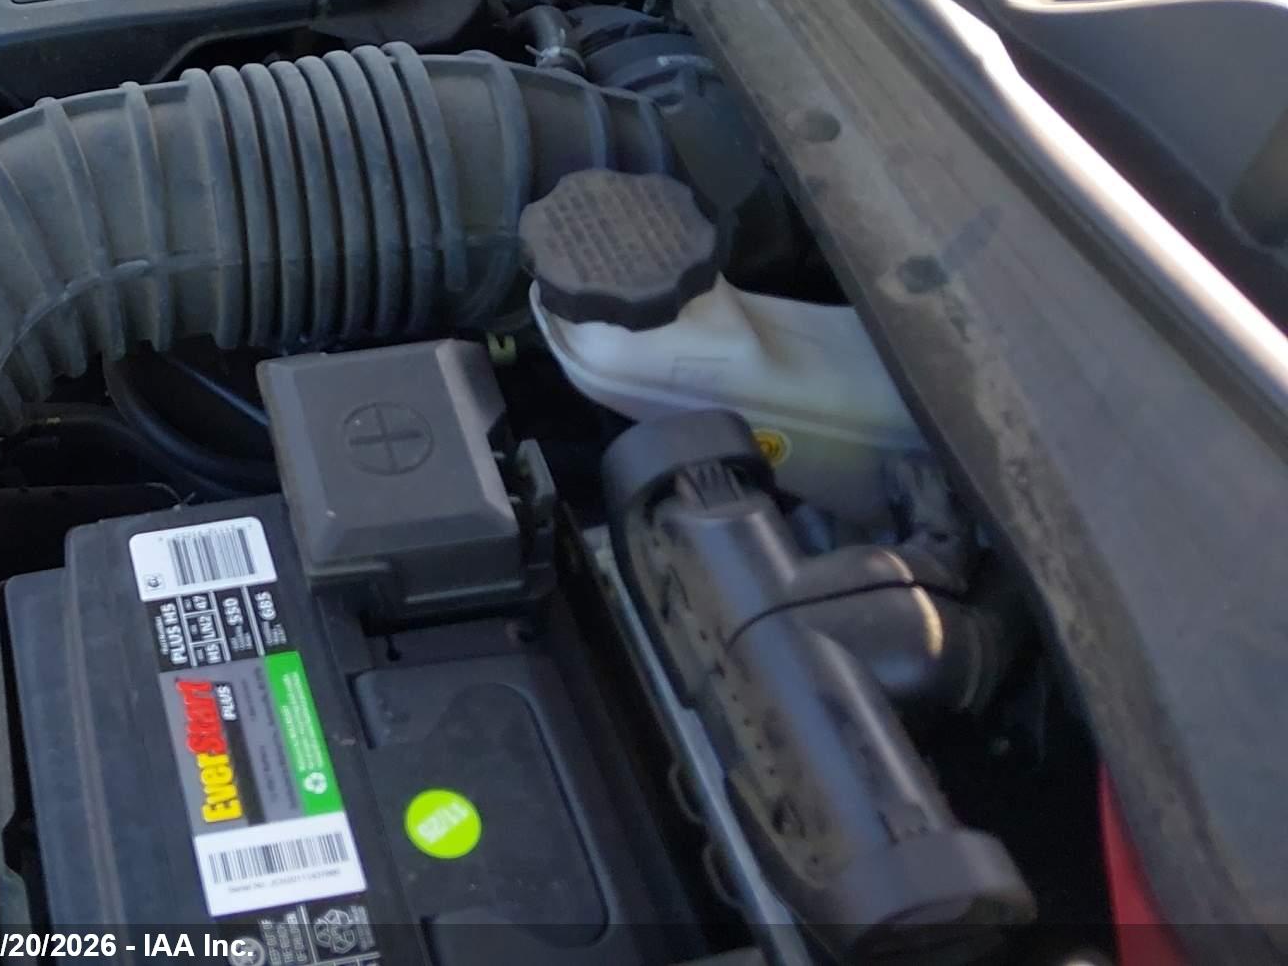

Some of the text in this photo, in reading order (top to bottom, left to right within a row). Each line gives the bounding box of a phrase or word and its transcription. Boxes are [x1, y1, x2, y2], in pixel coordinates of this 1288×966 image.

[192, 595, 208, 611] 47
[223, 597, 244, 626] 550
[160, 602, 188, 665] PLUS H5
[197, 615, 216, 641] LN2
[216, 685, 238, 721] PLUS
[176, 681, 243, 823] EverStart
